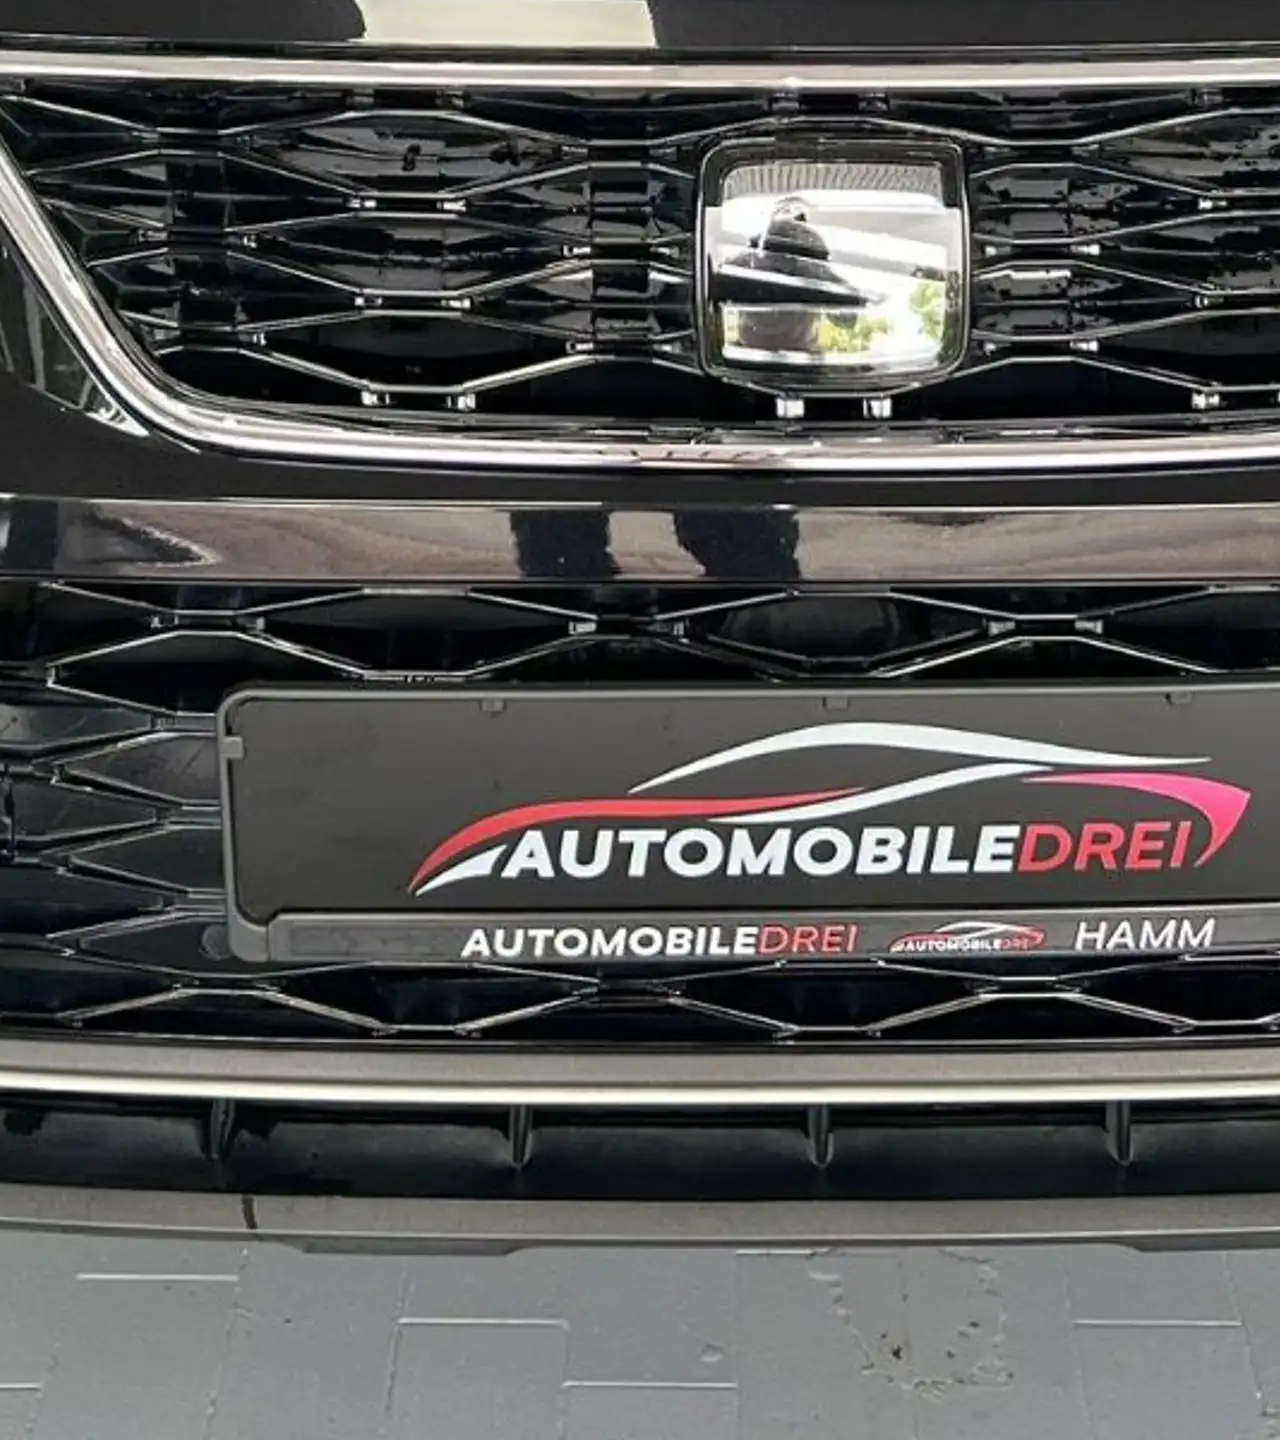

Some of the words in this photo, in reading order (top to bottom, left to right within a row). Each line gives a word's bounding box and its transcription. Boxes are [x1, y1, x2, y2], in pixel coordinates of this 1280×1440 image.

[501, 820, 1193, 879] AUTOMOBILEDREI
[460, 924, 858, 958] AUTOMOBILEDREI
[1073, 917, 1216, 951] HAMM
